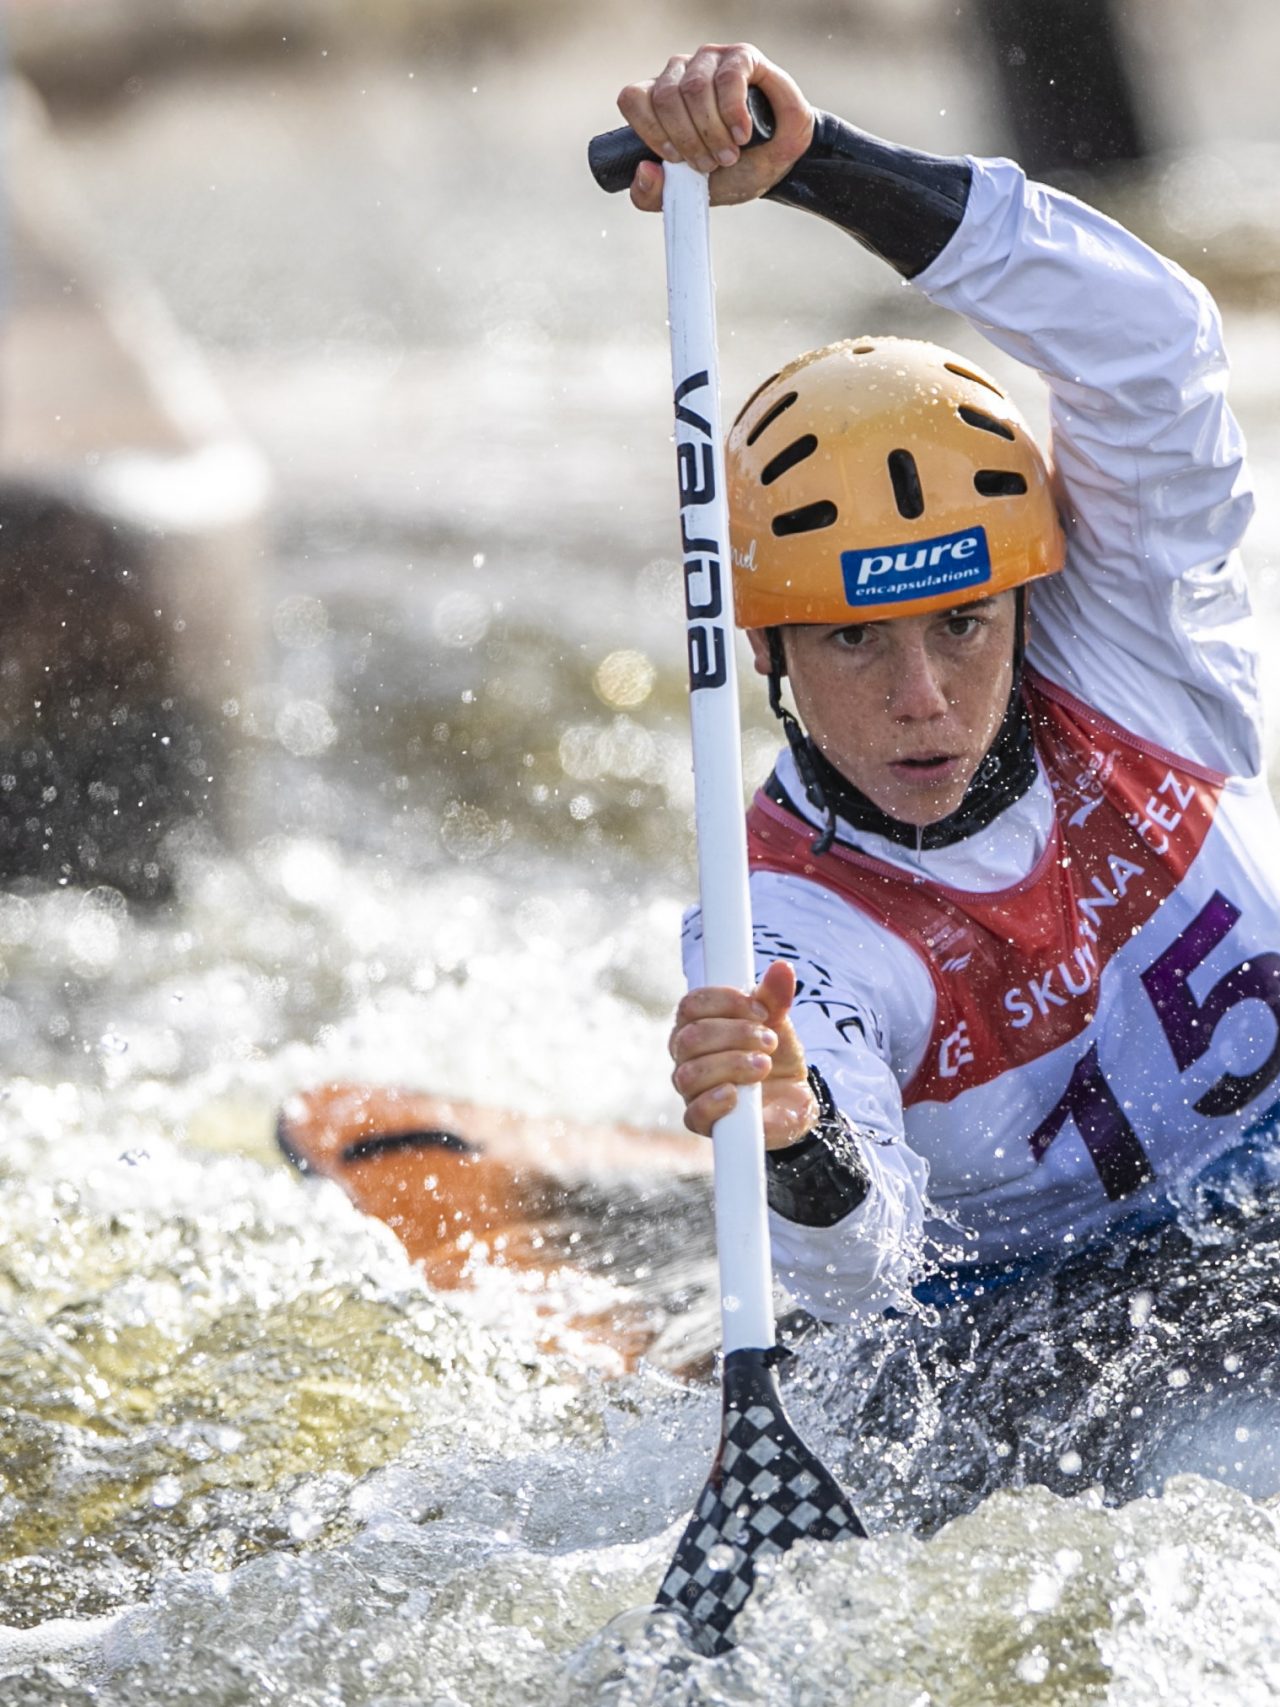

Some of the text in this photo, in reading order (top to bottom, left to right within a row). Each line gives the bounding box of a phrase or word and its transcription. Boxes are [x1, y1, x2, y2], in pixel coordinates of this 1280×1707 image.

[856, 566, 980, 596] encapsulations
[857, 537, 978, 585] pure
[1128, 770, 1196, 855] ČEZ
